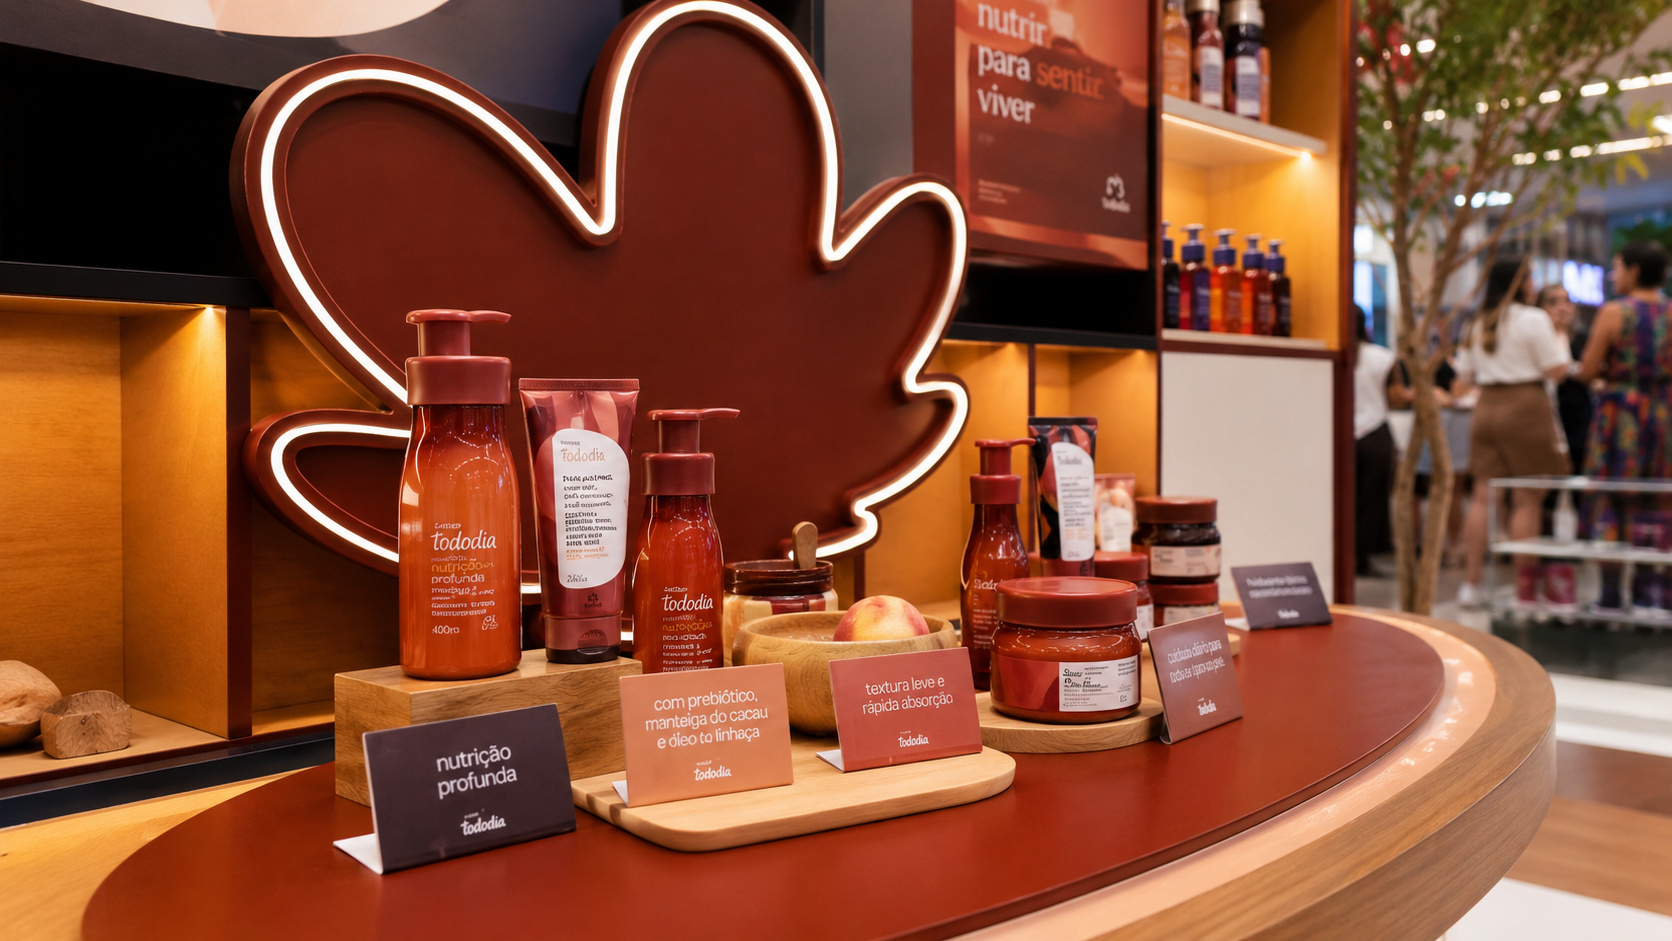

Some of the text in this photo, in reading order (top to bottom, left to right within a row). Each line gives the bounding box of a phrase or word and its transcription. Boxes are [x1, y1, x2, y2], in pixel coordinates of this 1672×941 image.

[977, 3, 1047, 46] nutrir
[977, 45, 1104, 100] para sentir
[976, 84, 1036, 124] viver
[430, 529, 497, 551] tododia
[661, 593, 714, 611] tododia
[865, 676, 945, 696] textura leve e
[654, 697, 685, 711] com
[862, 691, 954, 717] rápida absorção
[645, 708, 769, 732] manteiga do cacau
[657, 737, 667, 749] e
[715, 726, 760, 743] linhaça
[897, 734, 929, 748] tododia
[436, 745, 512, 772] nutrição
[437, 765, 518, 800] profunda
[694, 765, 732, 781] tododia
[460, 815, 507, 836] tododia
